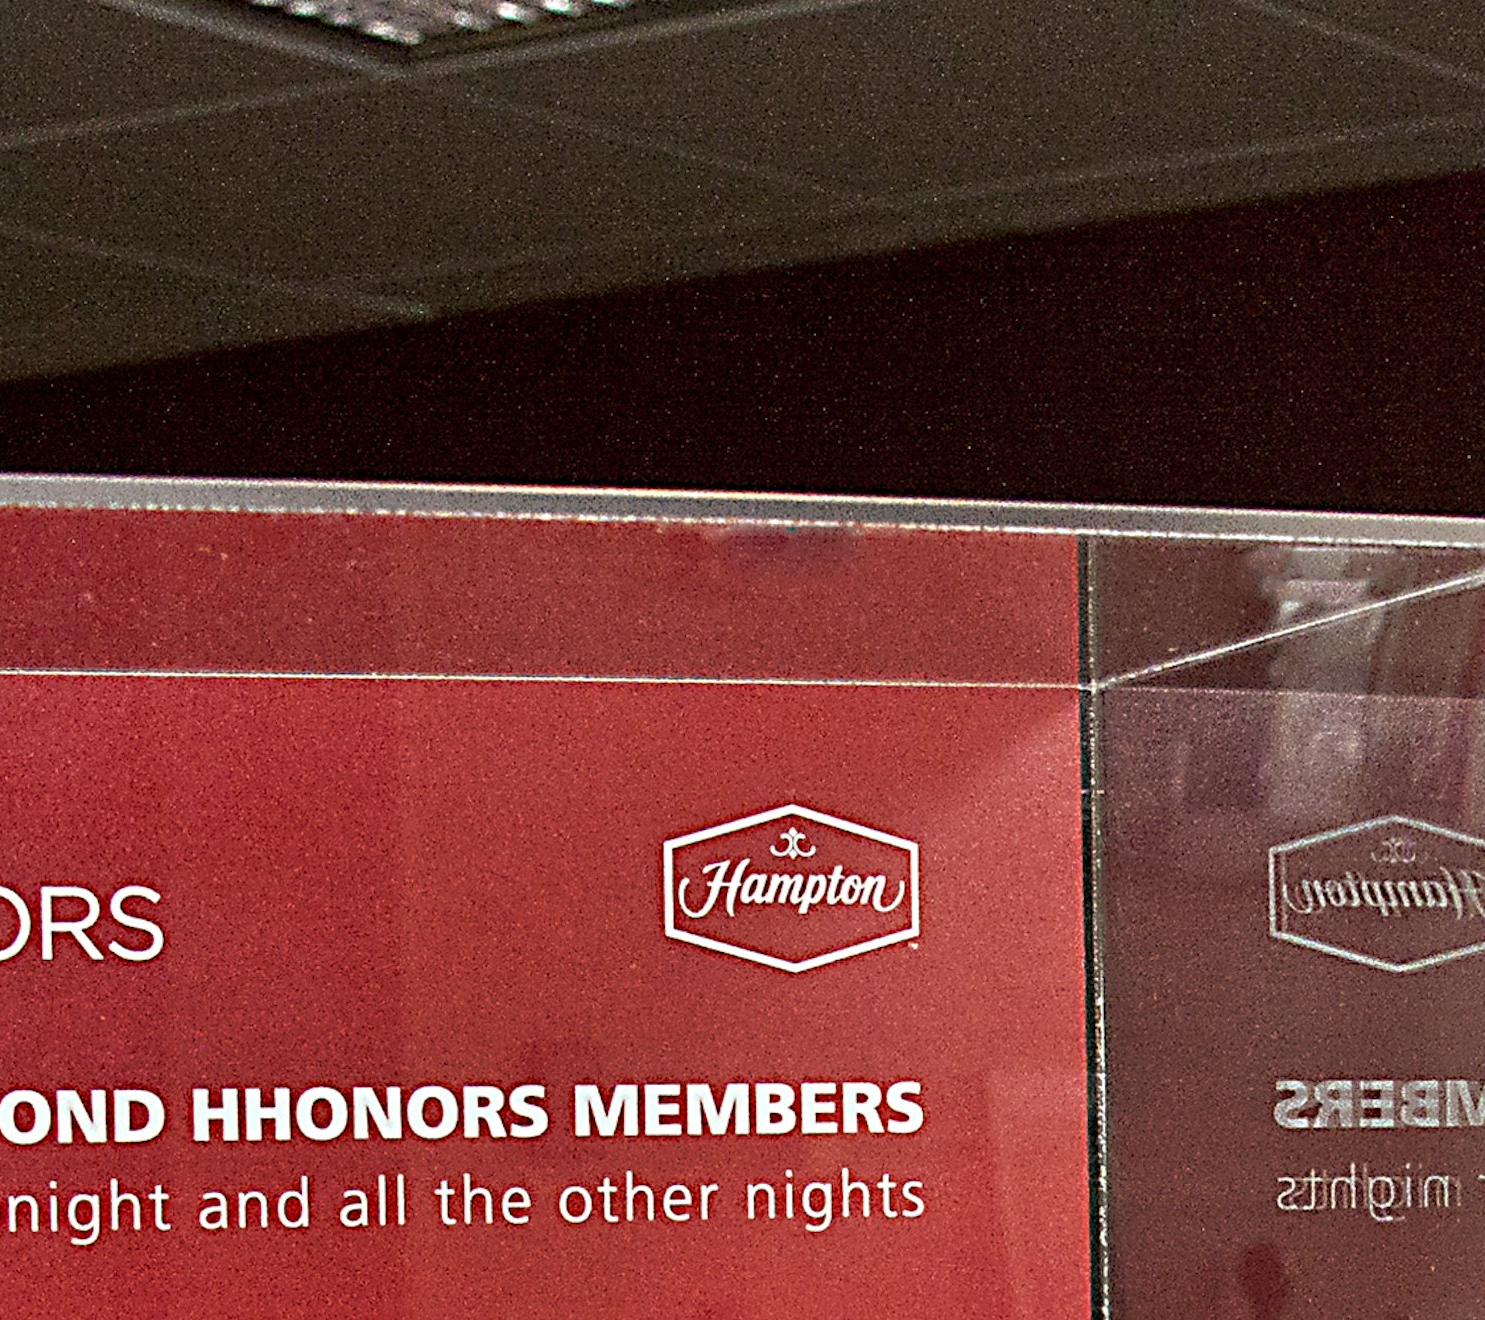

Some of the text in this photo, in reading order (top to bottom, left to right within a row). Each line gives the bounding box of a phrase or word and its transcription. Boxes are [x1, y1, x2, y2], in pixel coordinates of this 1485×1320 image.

[678, 860, 906, 915] Hampton
[191, 1082, 549, 1142] HHONORS
[573, 1080, 924, 1138] MEMBERS
[197, 1174, 310, 1229] and
[339, 1174, 407, 1227] all
[434, 1173, 533, 1225] the
[558, 1169, 720, 1225] other
[746, 1167, 925, 1231] nights
